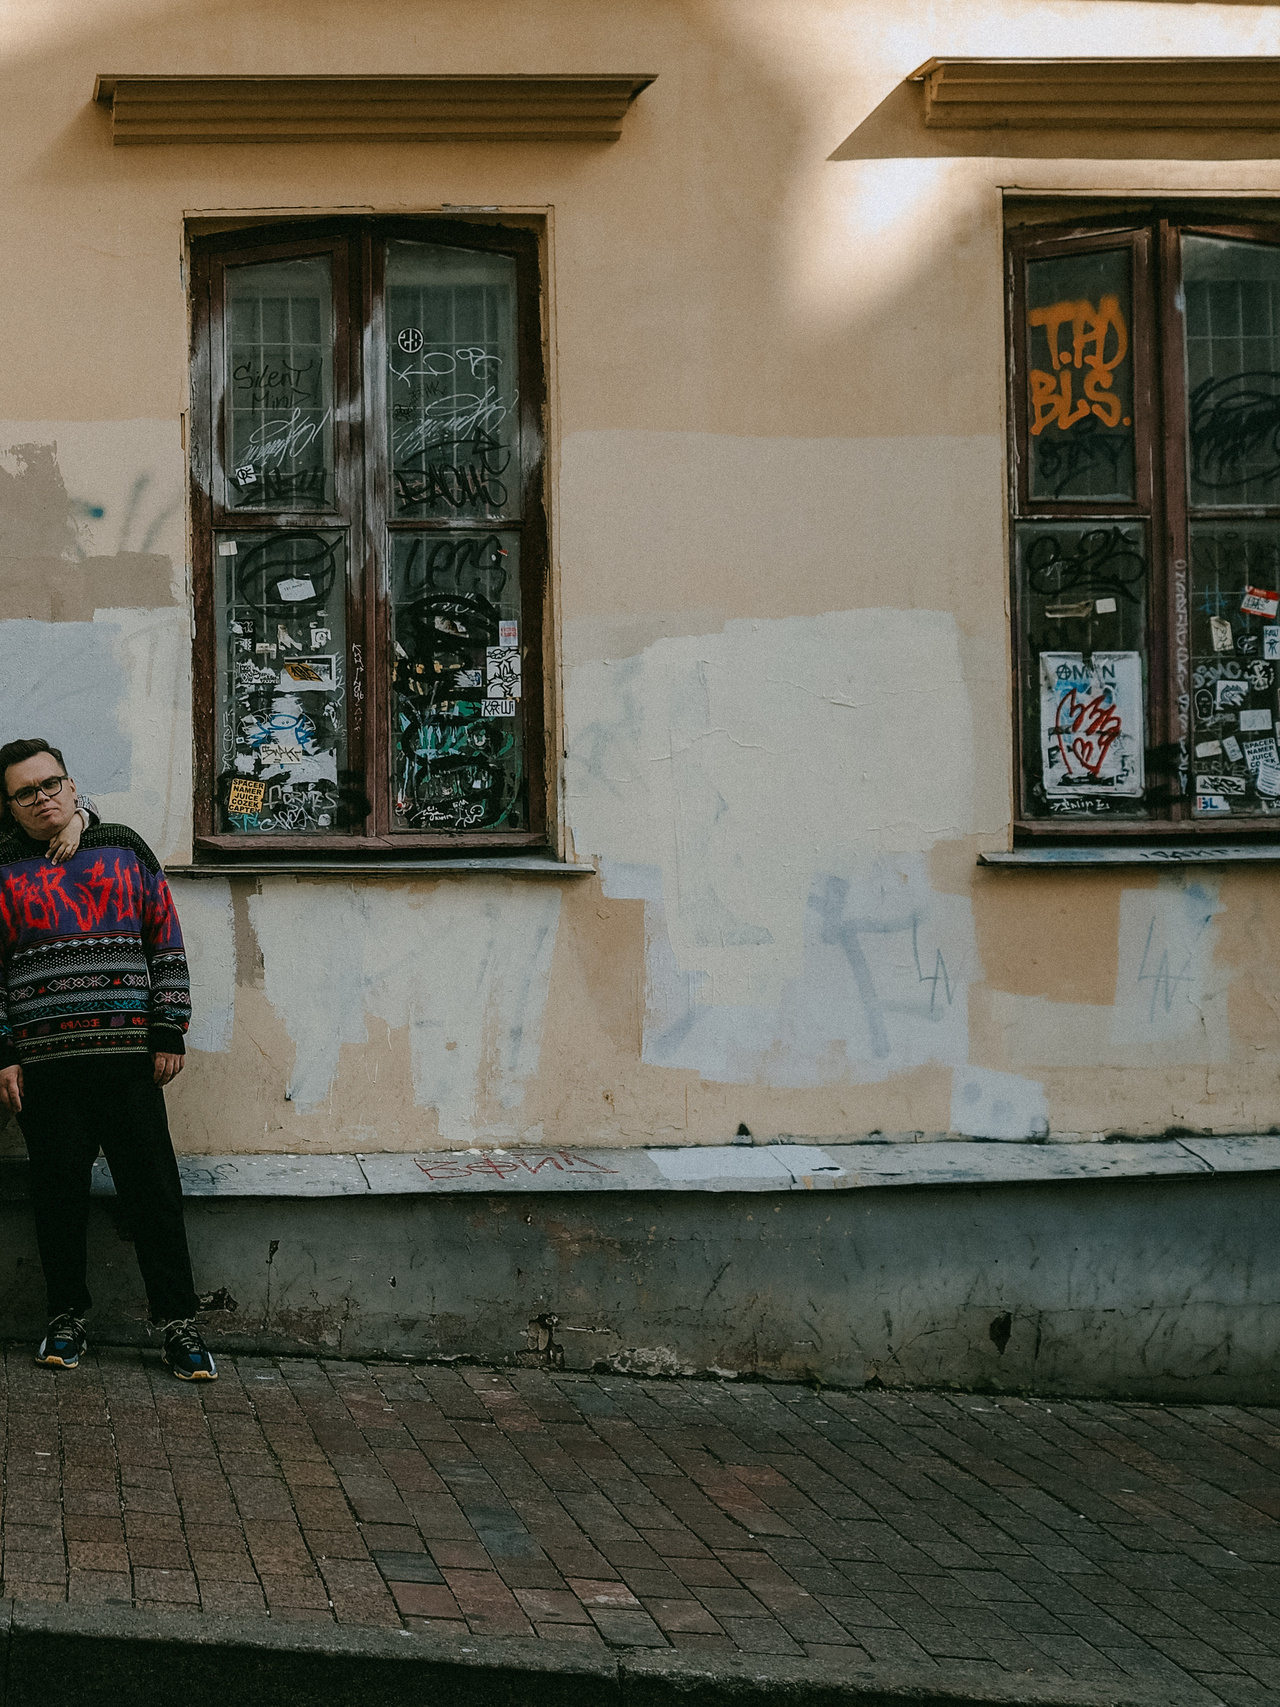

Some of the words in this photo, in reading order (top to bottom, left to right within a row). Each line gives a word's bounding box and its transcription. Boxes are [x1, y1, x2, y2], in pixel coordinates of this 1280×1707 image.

[1244, 739, 1275, 750] SPACER
[1247, 745, 1275, 755] NAMER
[1251, 752, 1273, 761] JUICE
[232, 779, 264, 790] SPACER
[233, 786, 262, 796] NAMER
[234, 793, 259, 802] JUICE
[231, 798, 259, 808] COZEK
